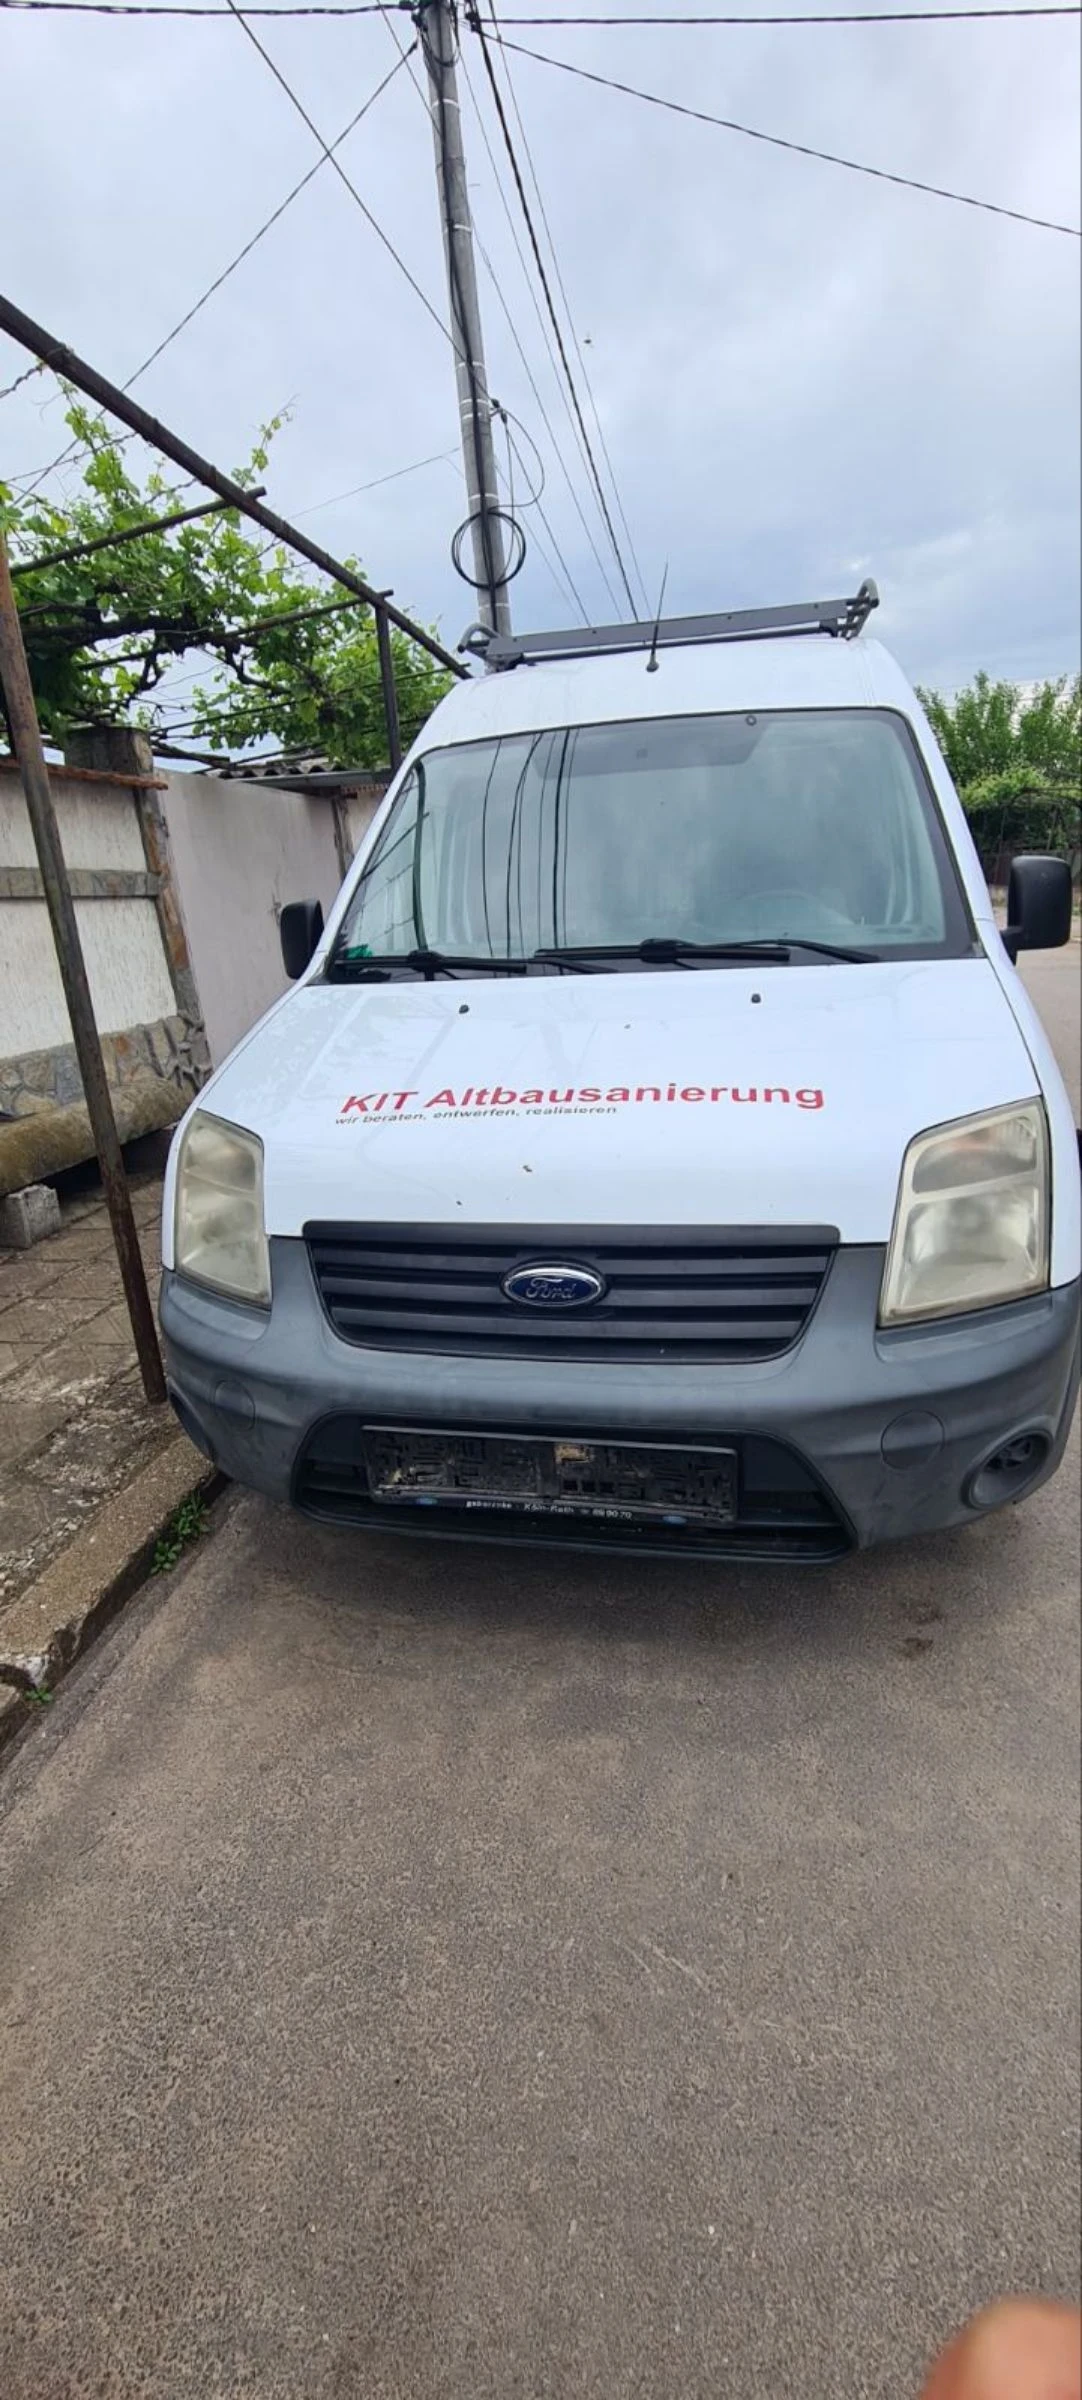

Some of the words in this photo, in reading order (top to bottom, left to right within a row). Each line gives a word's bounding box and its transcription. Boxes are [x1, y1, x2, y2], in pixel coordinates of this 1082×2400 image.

[340, 1091, 419, 1114] KIT
[424, 1083, 824, 1110] Altbausanierung
[335, 1116, 359, 1125] wir
[362, 1113, 426, 1123] beraten,
[432, 1108, 520, 1119] entwerfen,
[526, 1106, 617, 1116] realisieren
[526, 1277, 577, 1299] Ford
